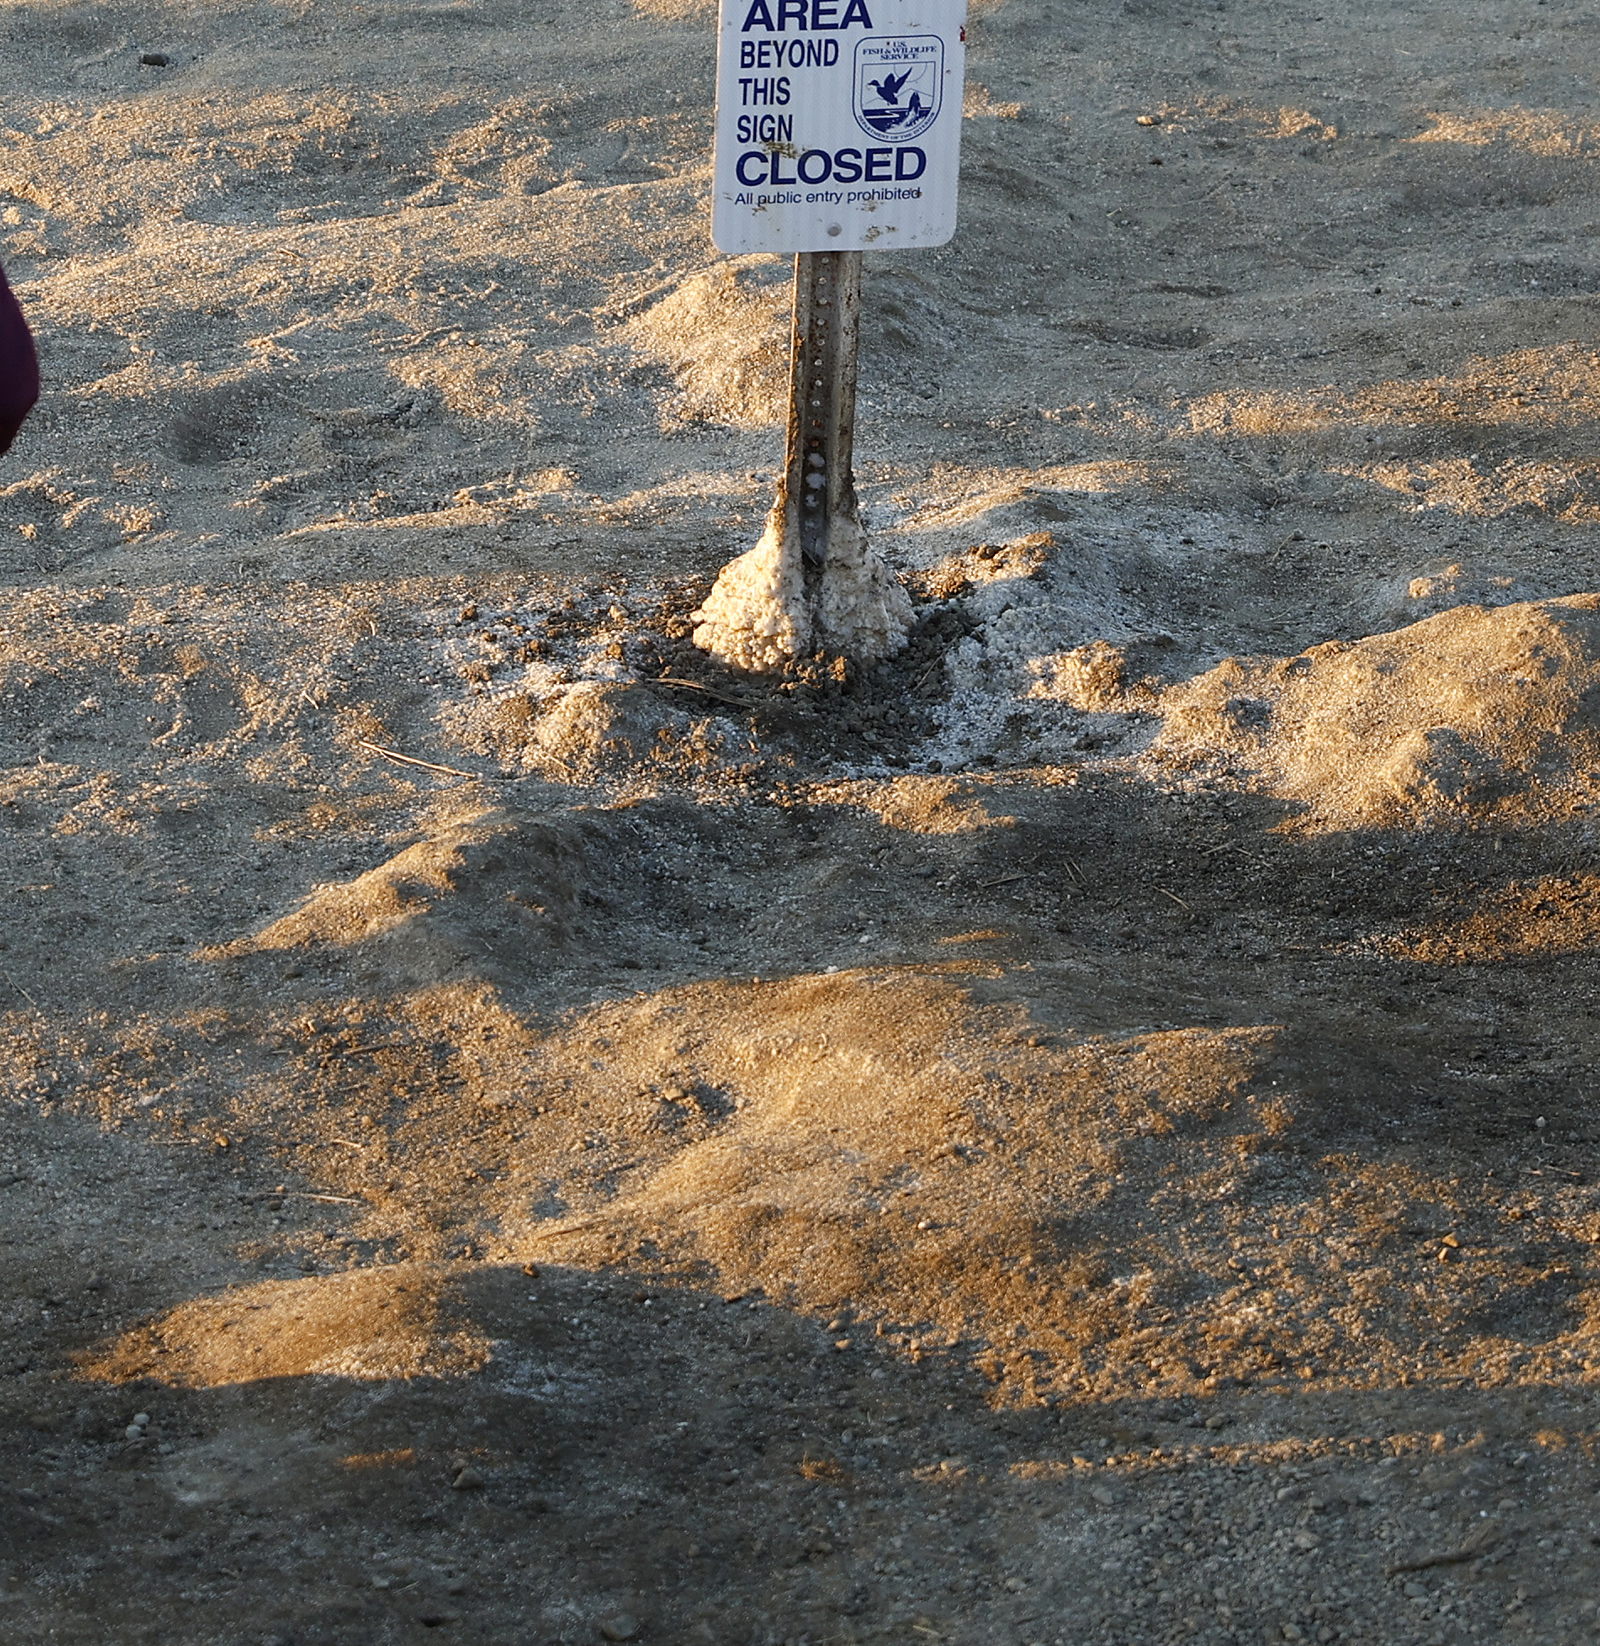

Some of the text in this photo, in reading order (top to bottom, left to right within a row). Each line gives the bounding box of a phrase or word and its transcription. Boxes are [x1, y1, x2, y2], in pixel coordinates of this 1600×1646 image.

[740, 38, 839, 69] BEYOND
[892, 46, 937, 54] WILDLIFE
[738, 76, 791, 106] THIS
[736, 114, 793, 144] SIGN
[735, 146, 927, 186] CLOSED
[734, 186, 921, 207] All public entry prohibited
